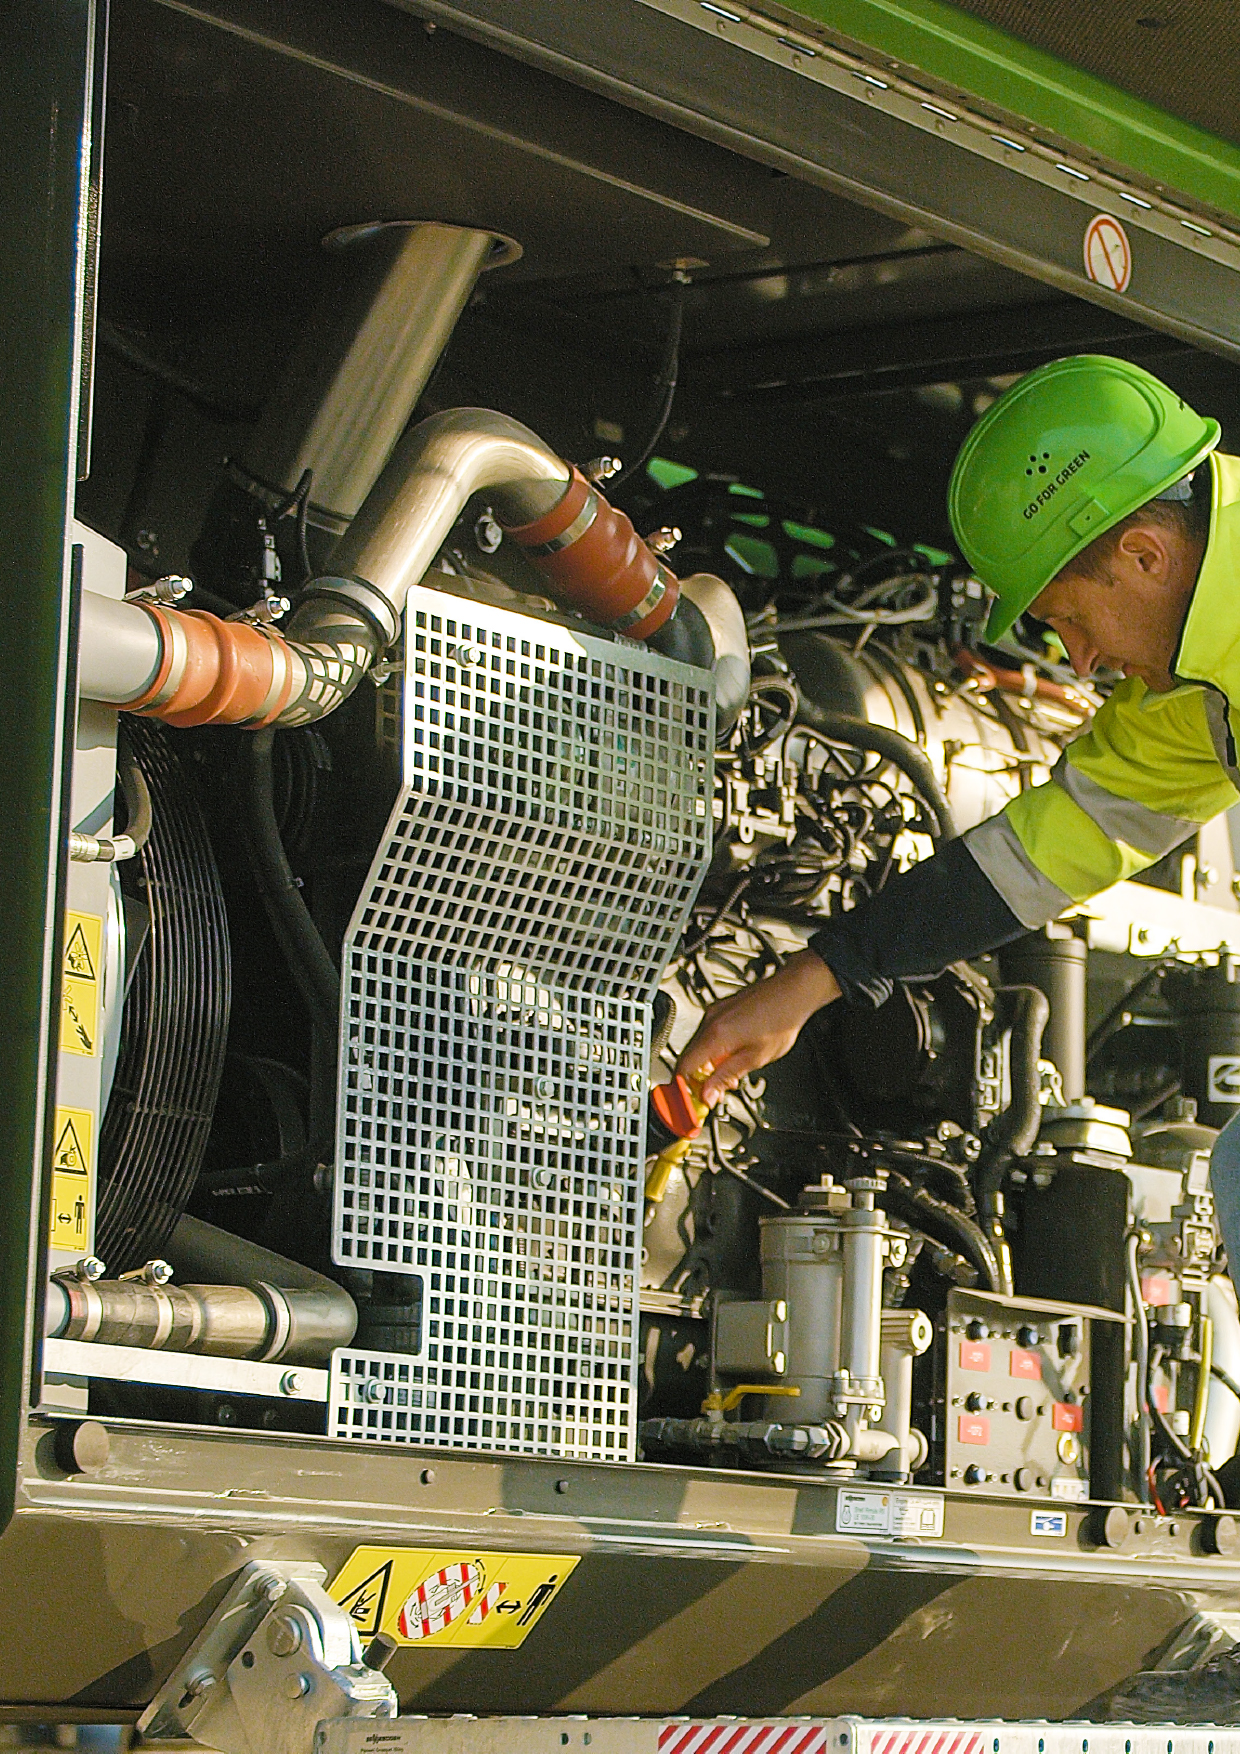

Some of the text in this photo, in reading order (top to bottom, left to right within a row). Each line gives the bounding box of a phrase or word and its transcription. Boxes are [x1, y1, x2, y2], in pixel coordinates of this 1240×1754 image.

[1023, 450, 1090, 519] GO FOR GREEN
